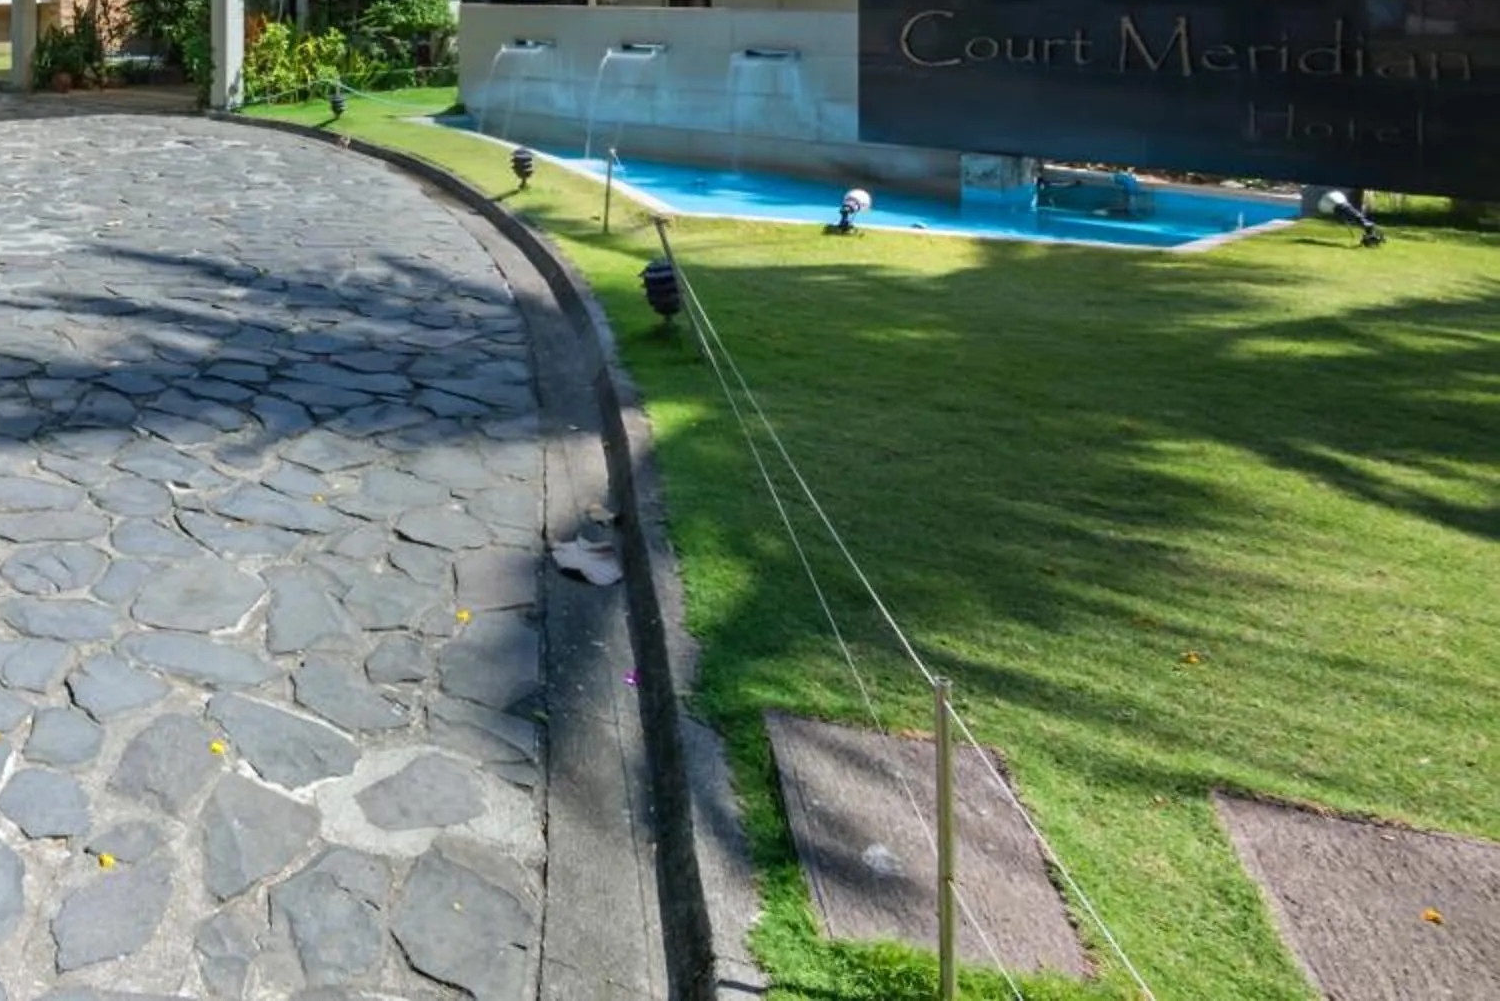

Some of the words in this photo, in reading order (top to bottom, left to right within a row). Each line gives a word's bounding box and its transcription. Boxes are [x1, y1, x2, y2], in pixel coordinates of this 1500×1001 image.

[900, 9, 1093, 68] Court
[1118, 13, 1472, 82] Meridian
[1247, 101, 1425, 146] Hotel
